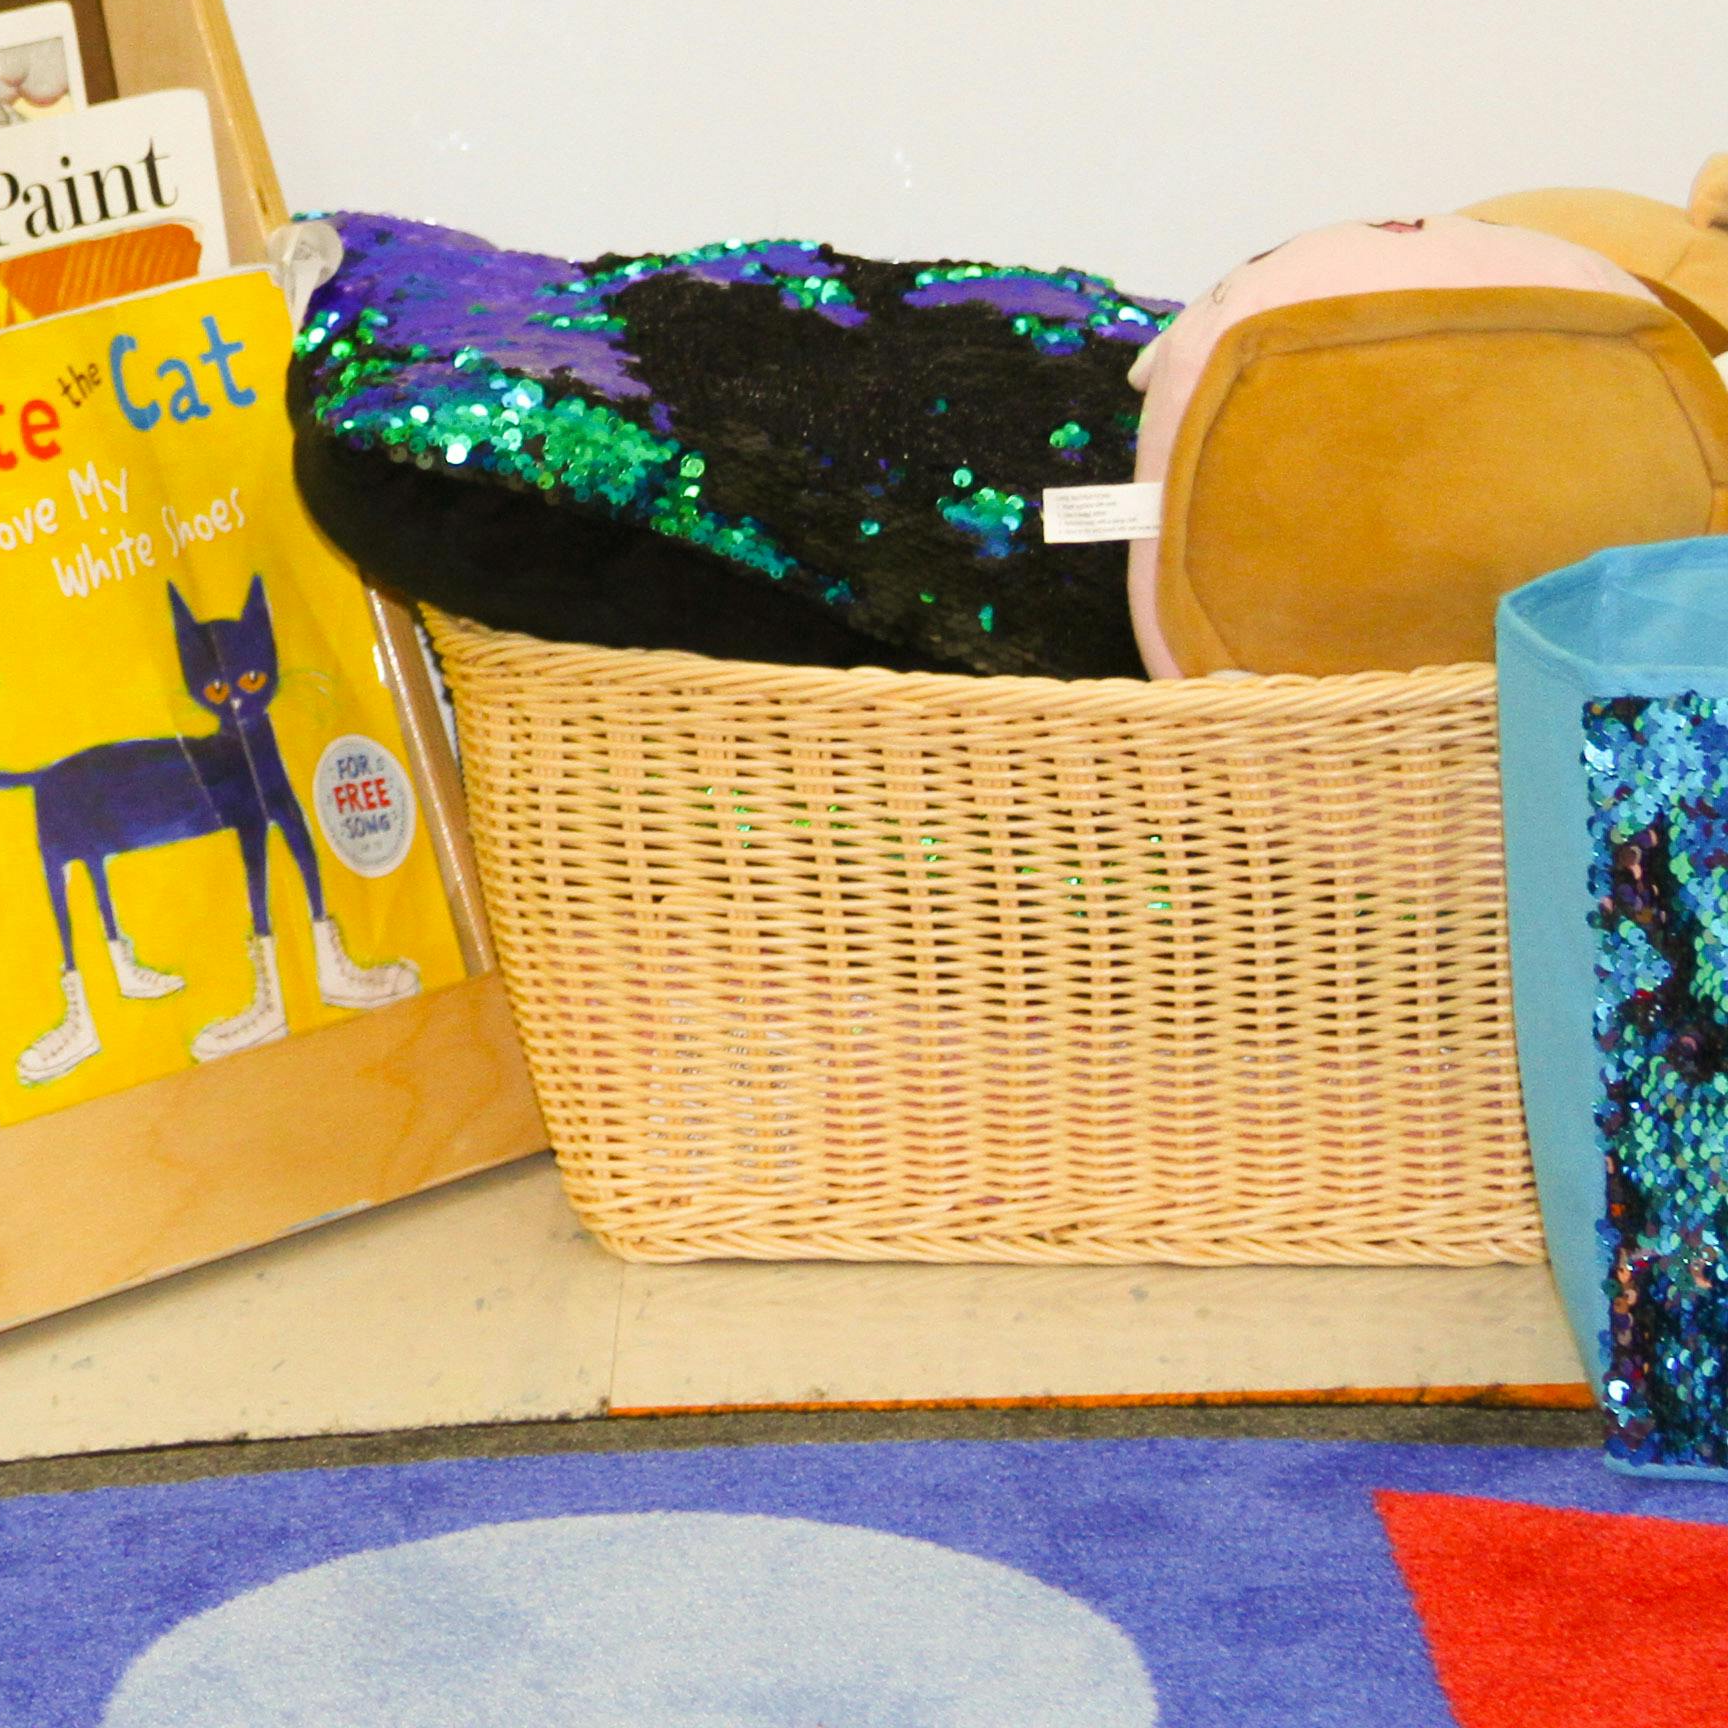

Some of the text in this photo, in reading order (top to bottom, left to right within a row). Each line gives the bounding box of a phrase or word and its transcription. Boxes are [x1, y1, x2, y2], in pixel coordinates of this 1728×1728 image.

[57, 362, 102, 409] the
[109, 315, 257, 432] Cat
[67, 460, 129, 521] My
[51, 487, 245, 599] White Shoes
[333, 777, 392, 813] FREE
[336, 753, 372, 780] FOR
